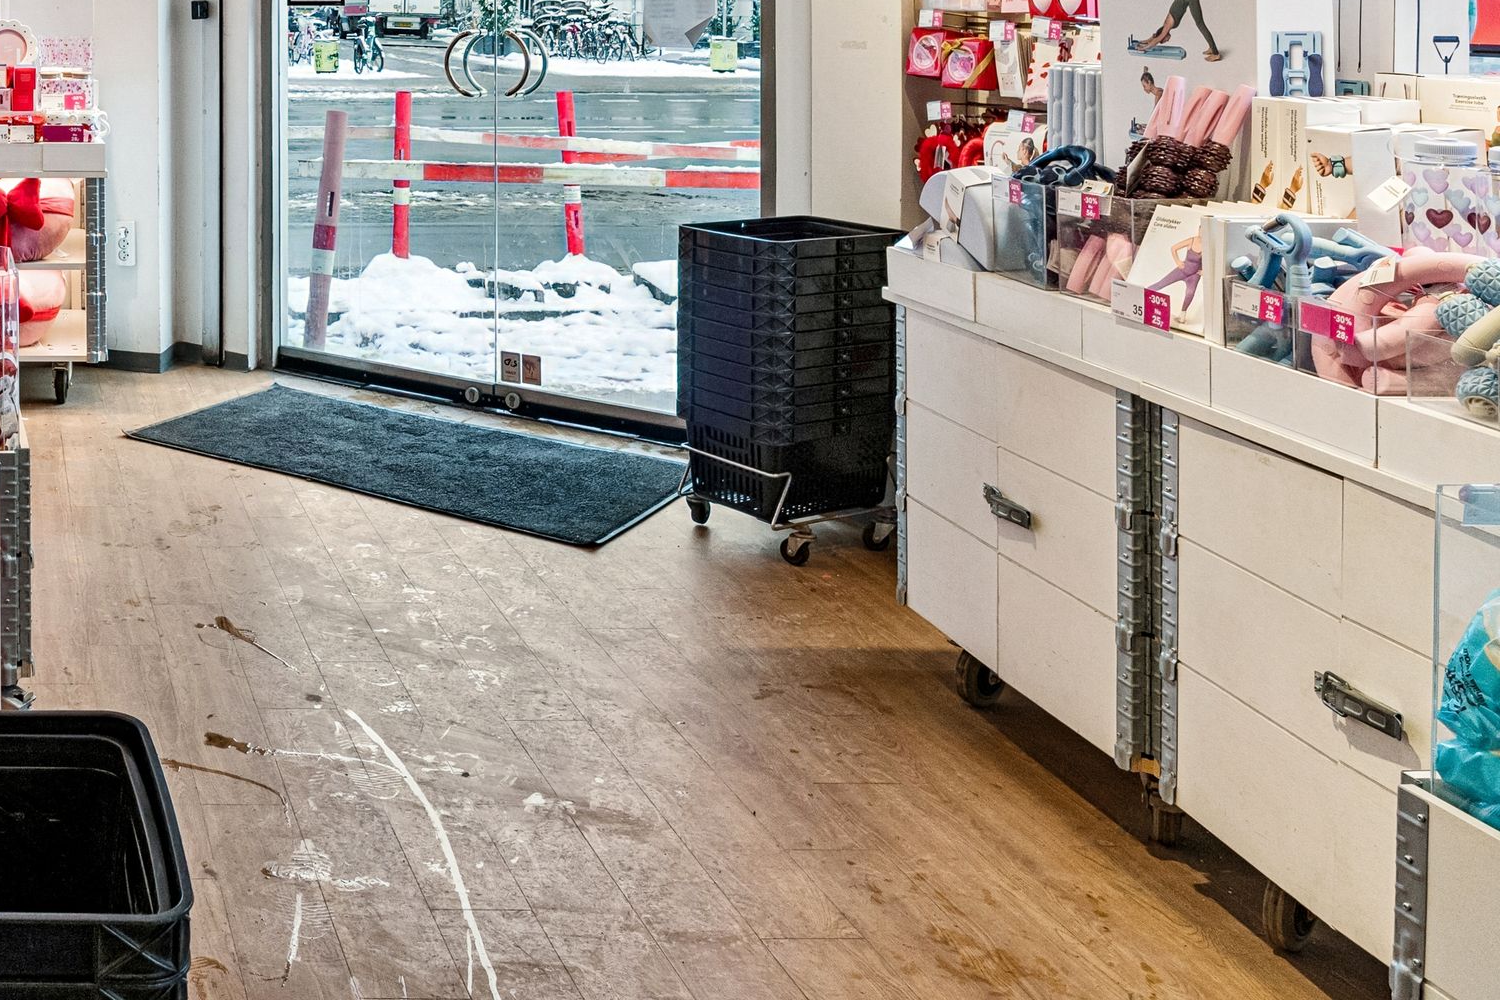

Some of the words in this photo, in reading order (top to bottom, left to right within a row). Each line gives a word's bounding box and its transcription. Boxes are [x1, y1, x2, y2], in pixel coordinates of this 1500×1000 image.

[1084, 196, 1099, 206] -30%
[1148, 294, 1168, 308] -30%
[1263, 295, 1280, 307] -30%
[1132, 304, 1143, 317] 35
[1333, 314, 1353, 327] -30%
